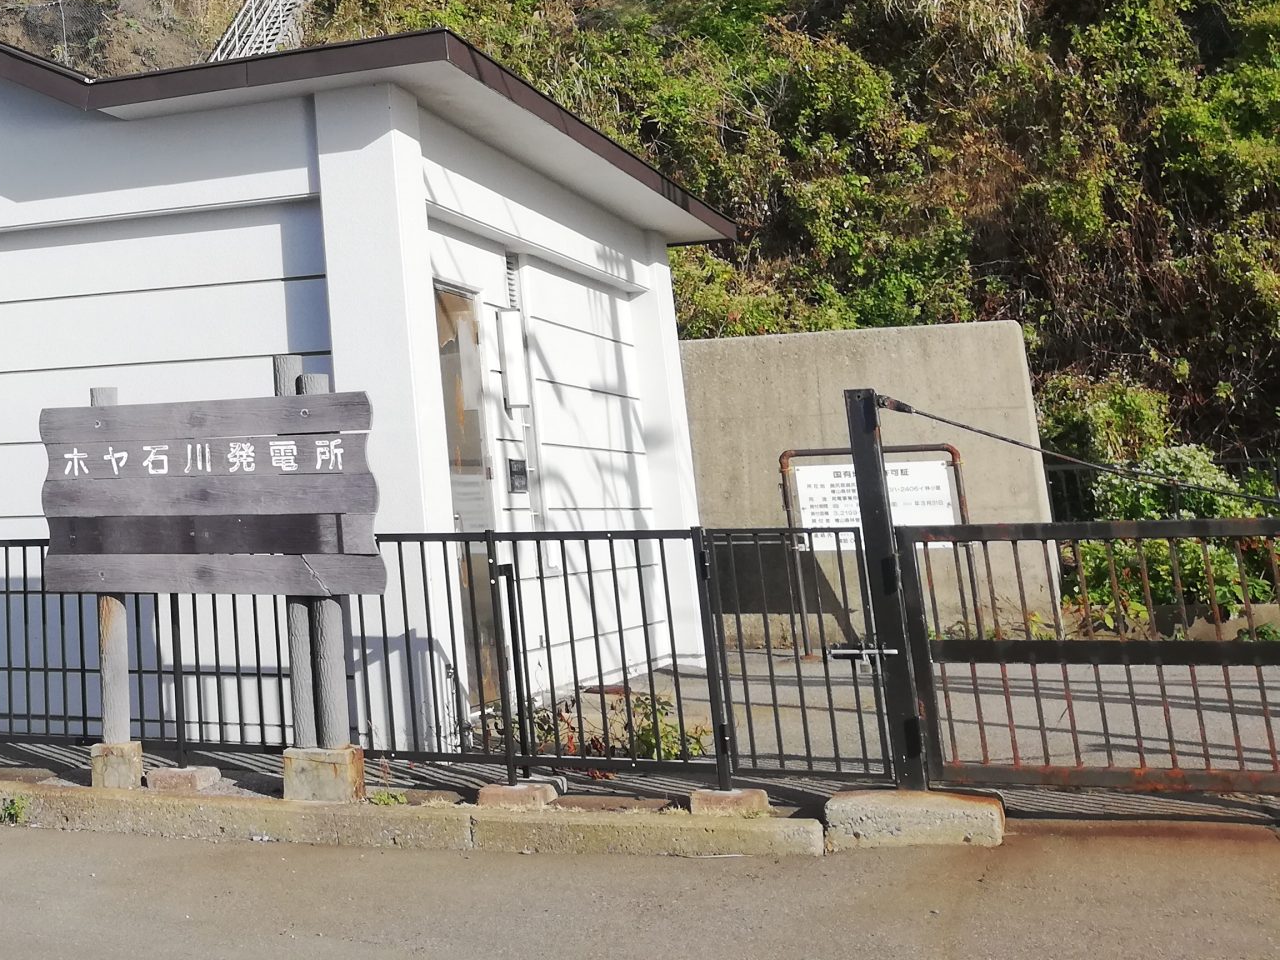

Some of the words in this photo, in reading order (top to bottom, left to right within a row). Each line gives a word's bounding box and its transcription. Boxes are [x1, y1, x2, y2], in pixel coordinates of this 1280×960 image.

[64, 439, 344, 476] ホヤ石川発電所
